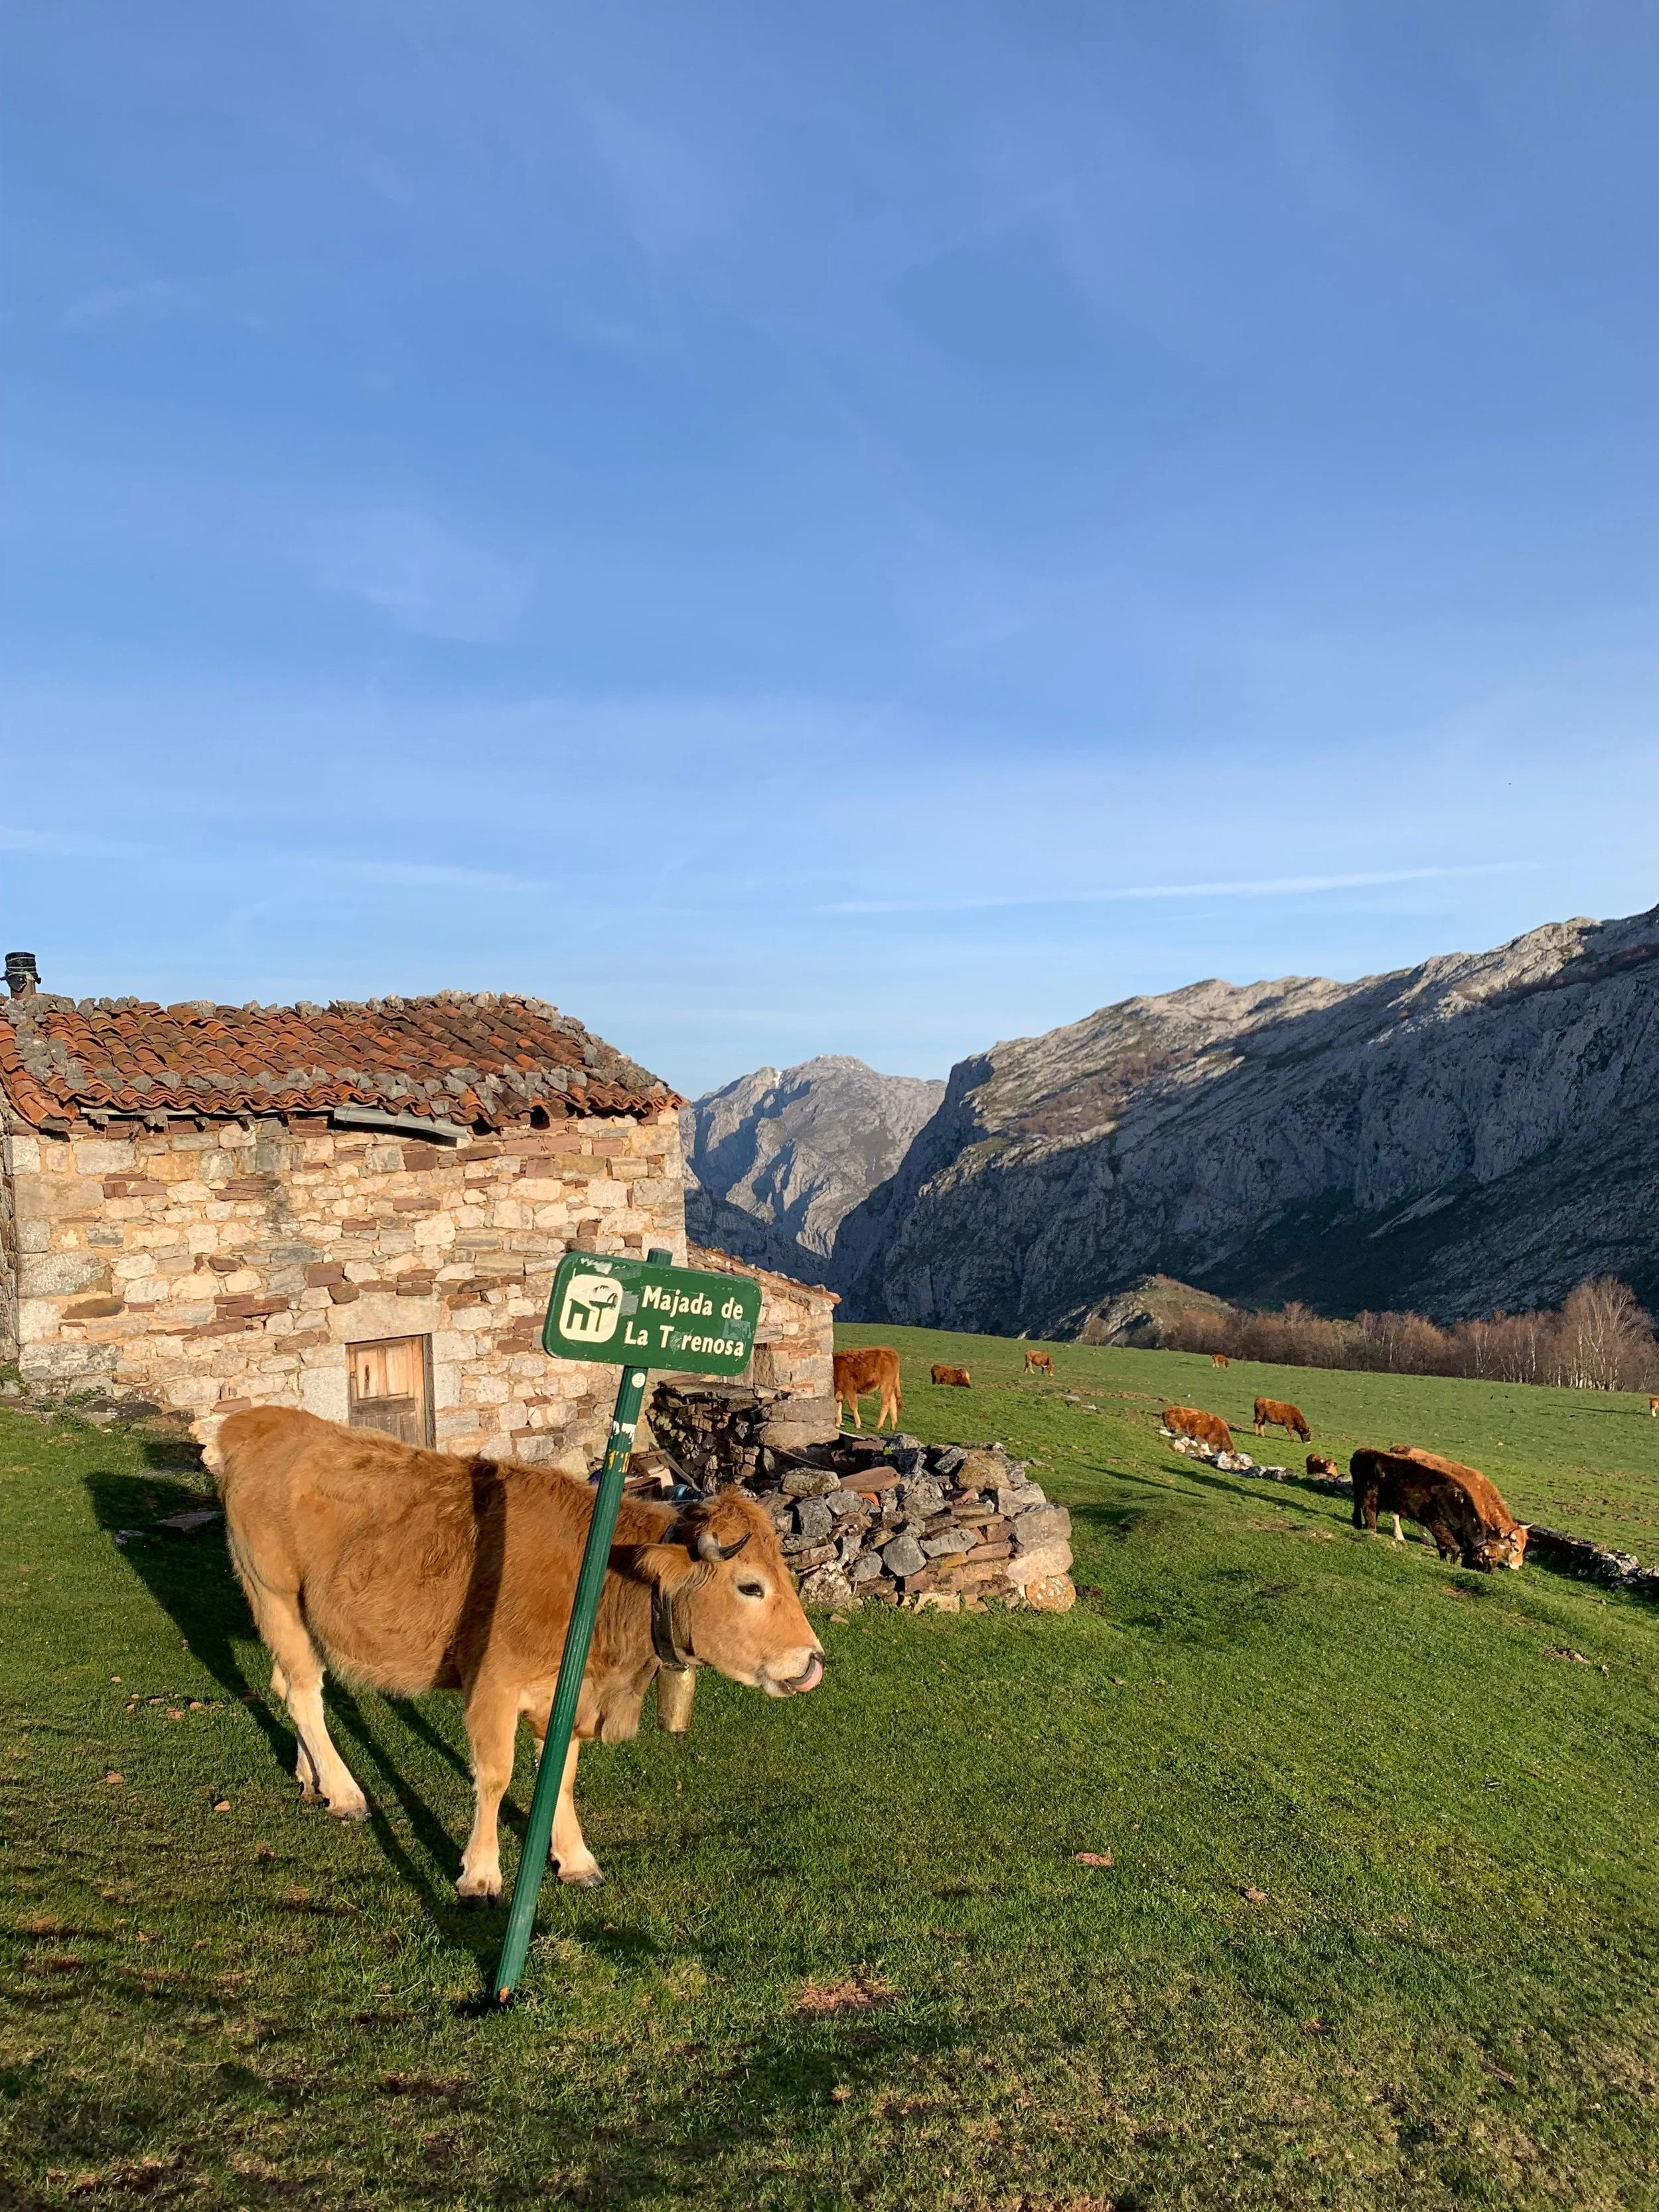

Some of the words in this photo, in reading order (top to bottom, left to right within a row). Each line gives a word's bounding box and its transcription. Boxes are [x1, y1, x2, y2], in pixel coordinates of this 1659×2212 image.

[642, 1286, 713, 1317] Majada
[721, 1297, 743, 1320] de
[624, 1321, 648, 1346] La
[659, 1325, 744, 1357] Trenosa
